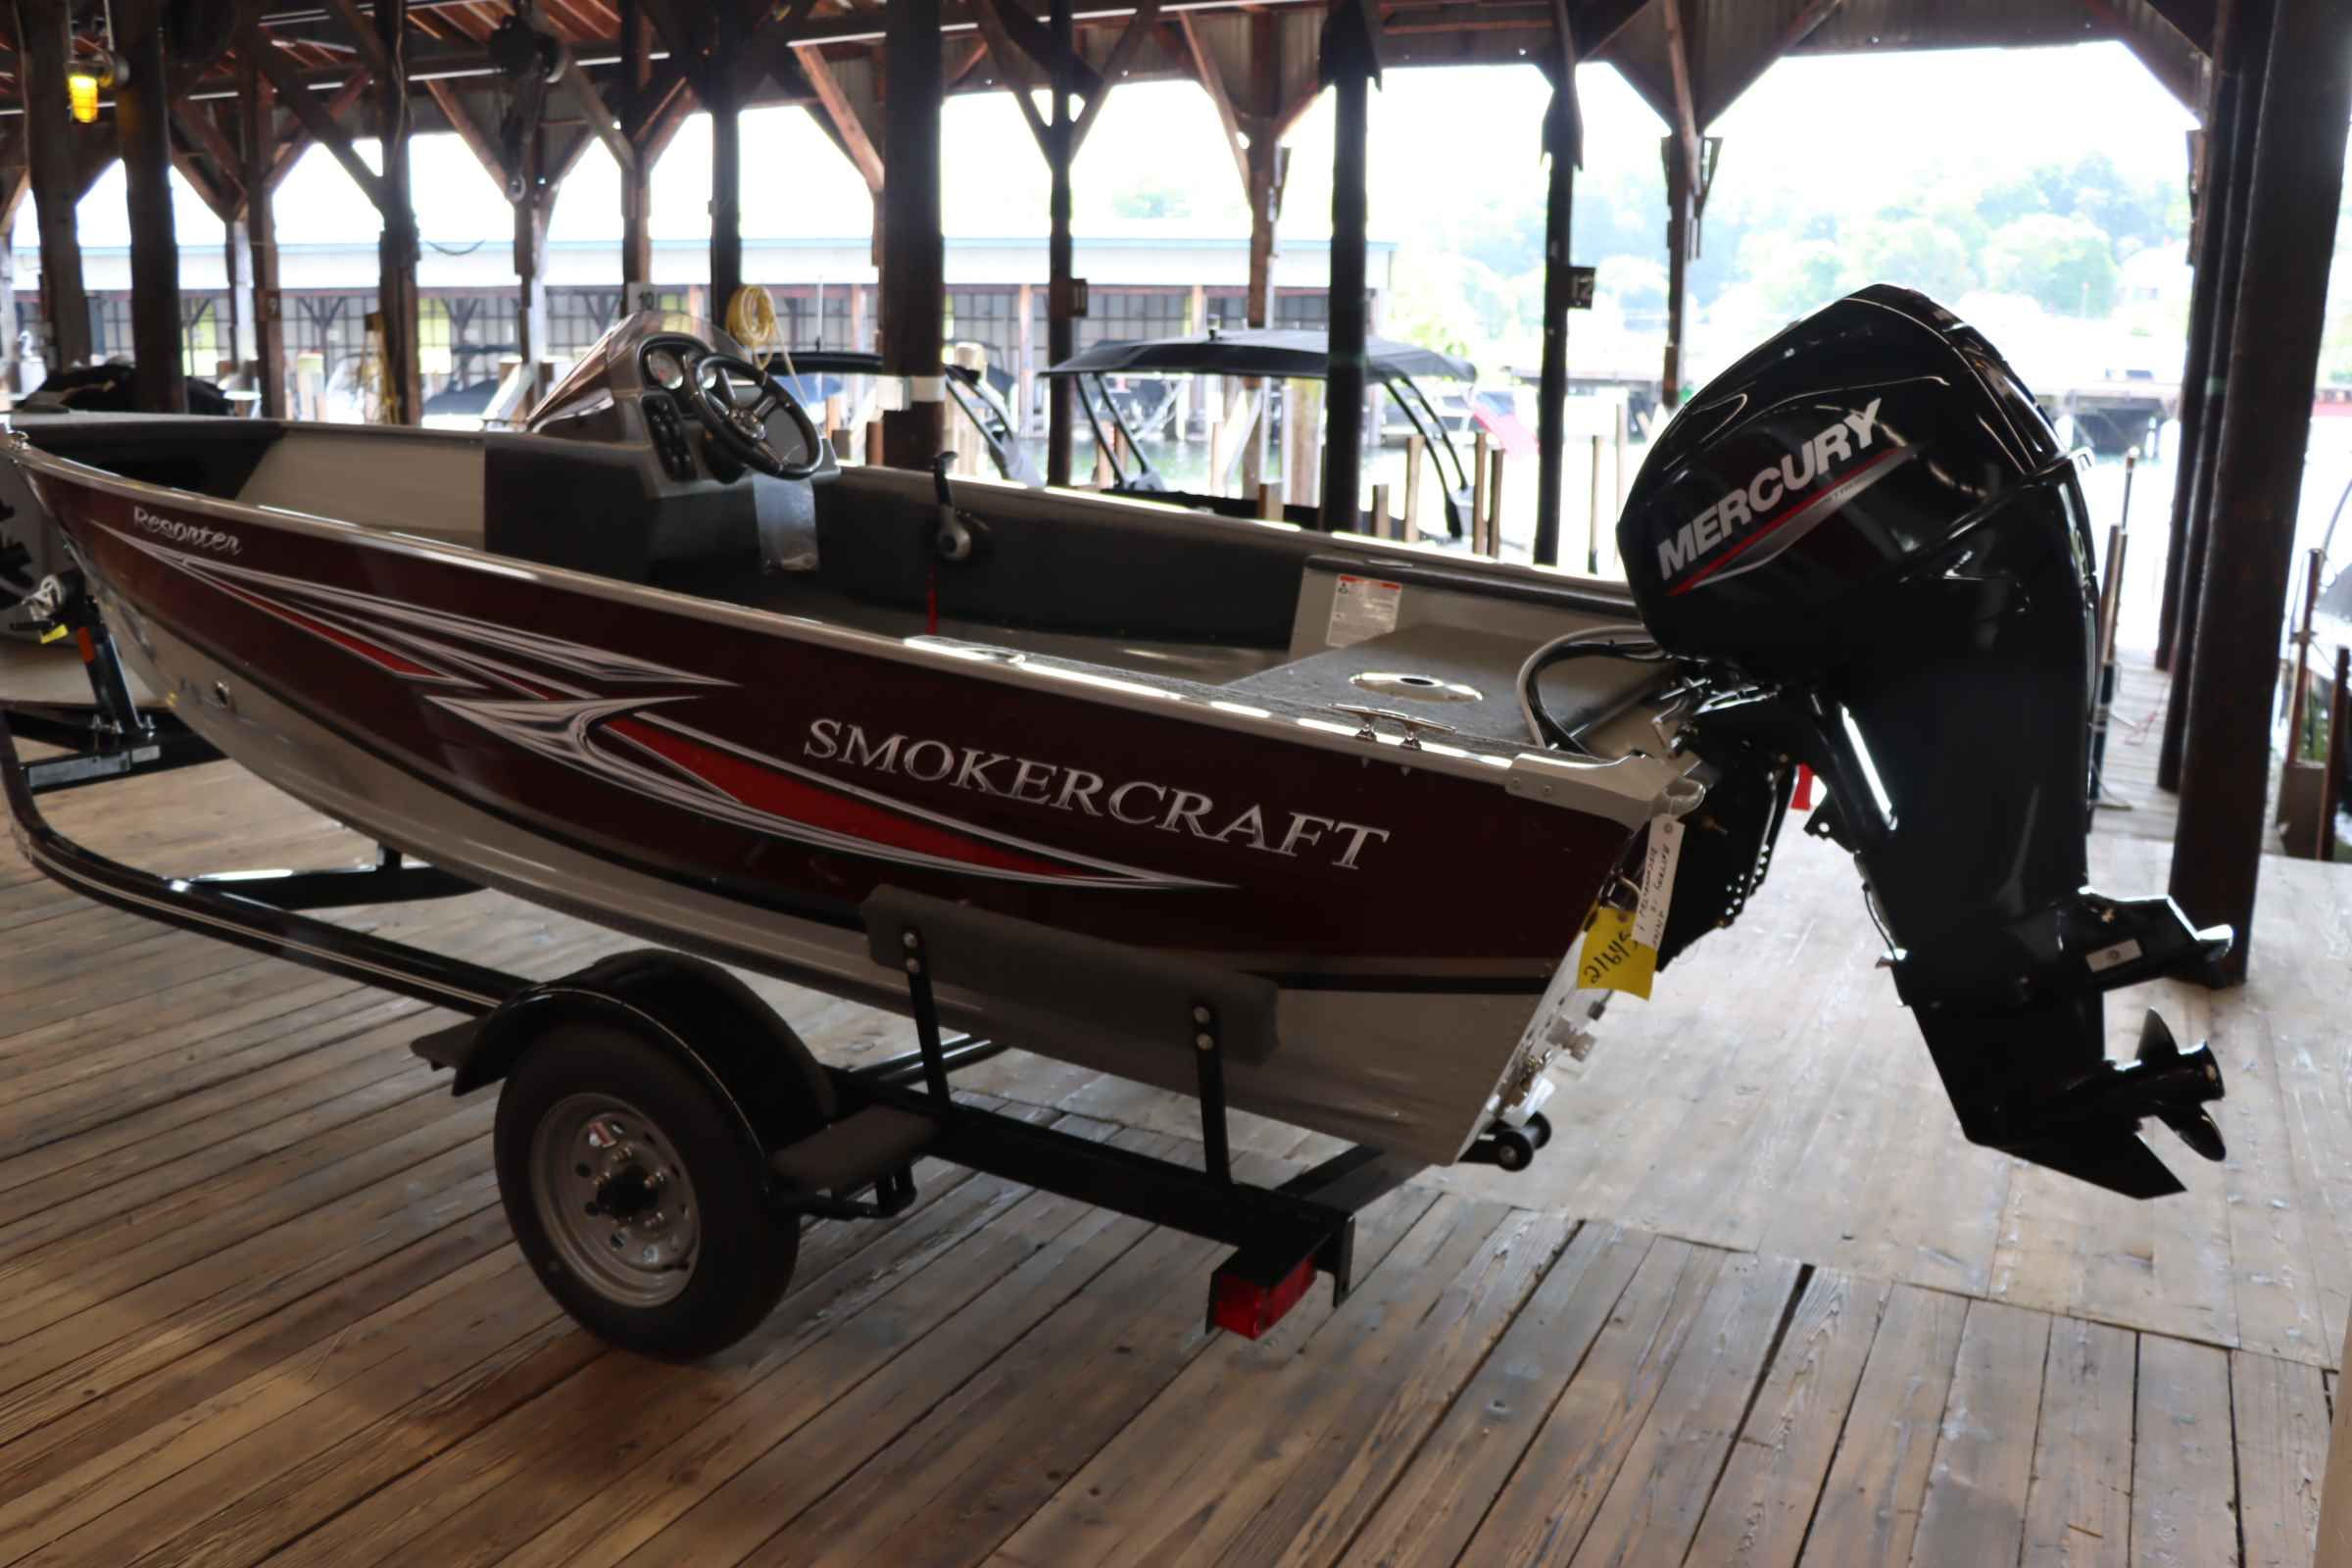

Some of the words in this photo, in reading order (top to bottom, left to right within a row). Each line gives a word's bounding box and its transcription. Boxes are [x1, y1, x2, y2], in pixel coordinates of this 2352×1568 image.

[638, 292, 655, 311] 10
[1572, 274, 1592, 299] 12
[1656, 398, 1881, 580] MERCURY
[804, 718, 1390, 870] SMOKERCRAFT
